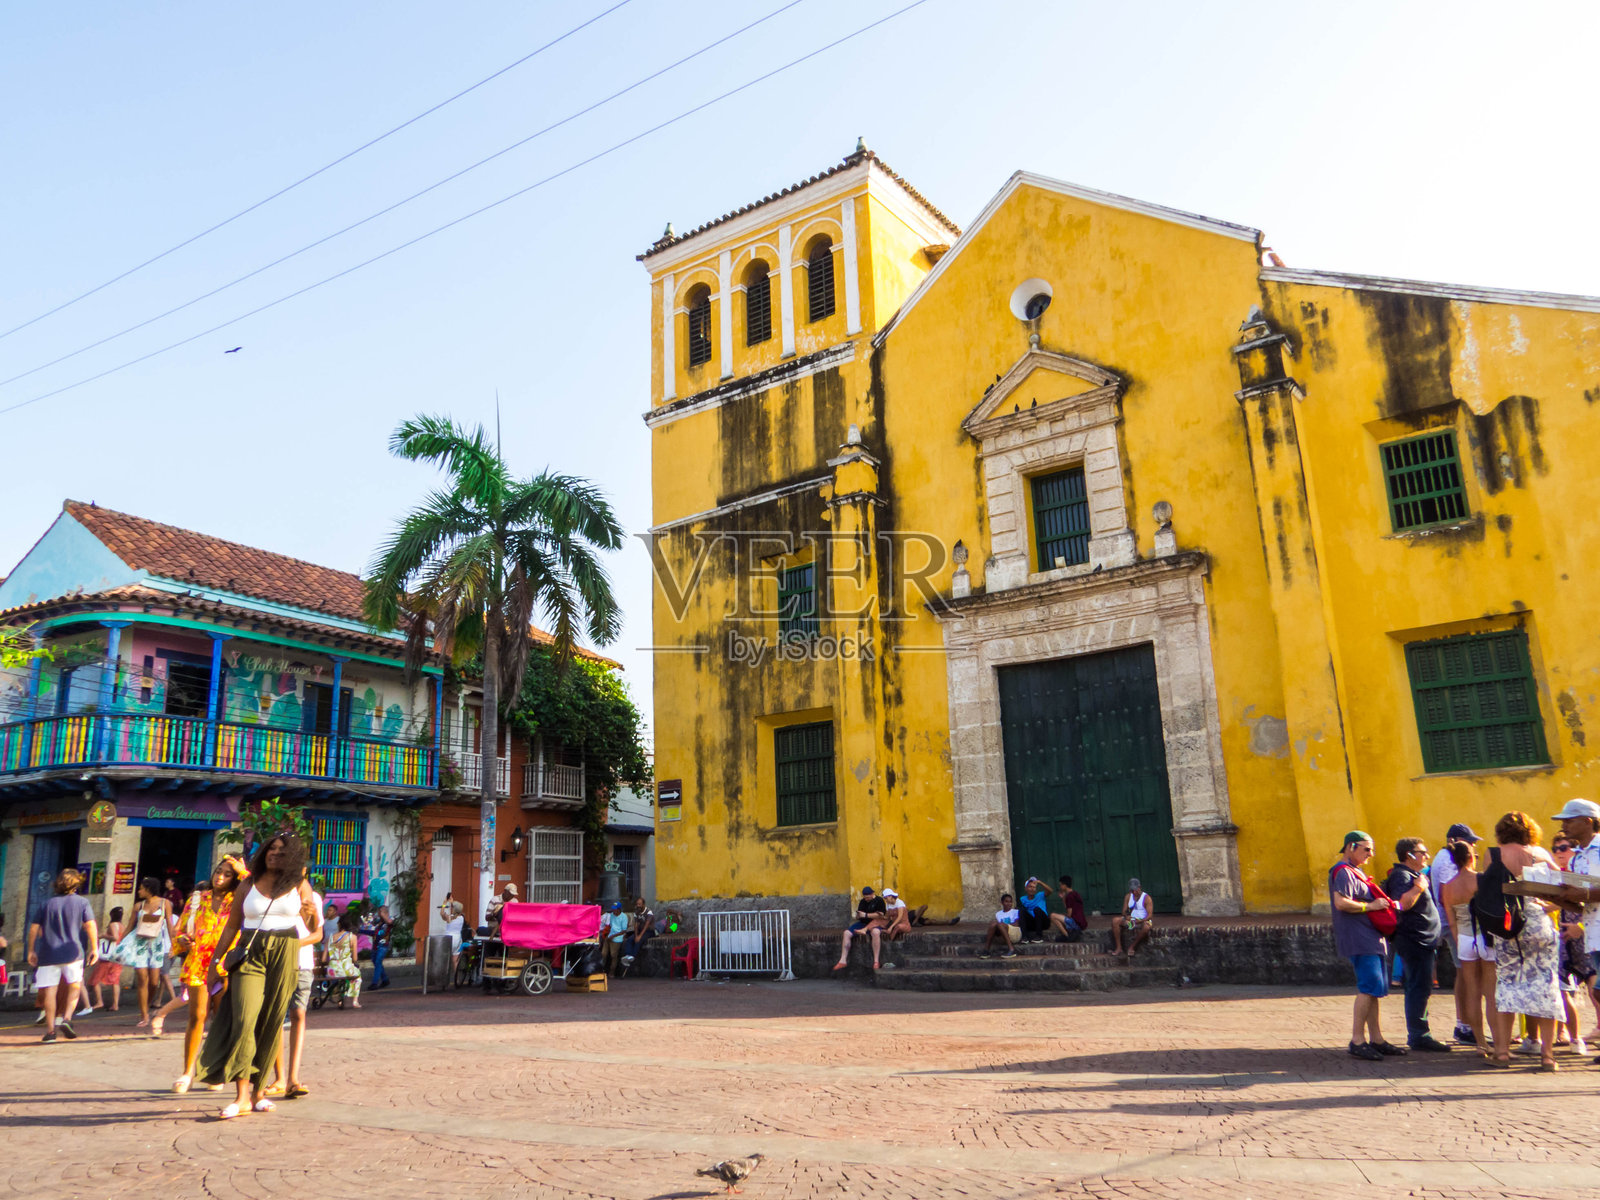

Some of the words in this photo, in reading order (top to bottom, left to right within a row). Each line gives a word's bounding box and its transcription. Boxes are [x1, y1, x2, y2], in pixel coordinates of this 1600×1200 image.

[244, 656, 272, 672] Club
[274, 659, 312, 676] House
[147, 805, 174, 819] Casa
[175, 805, 226, 824] Palenque
